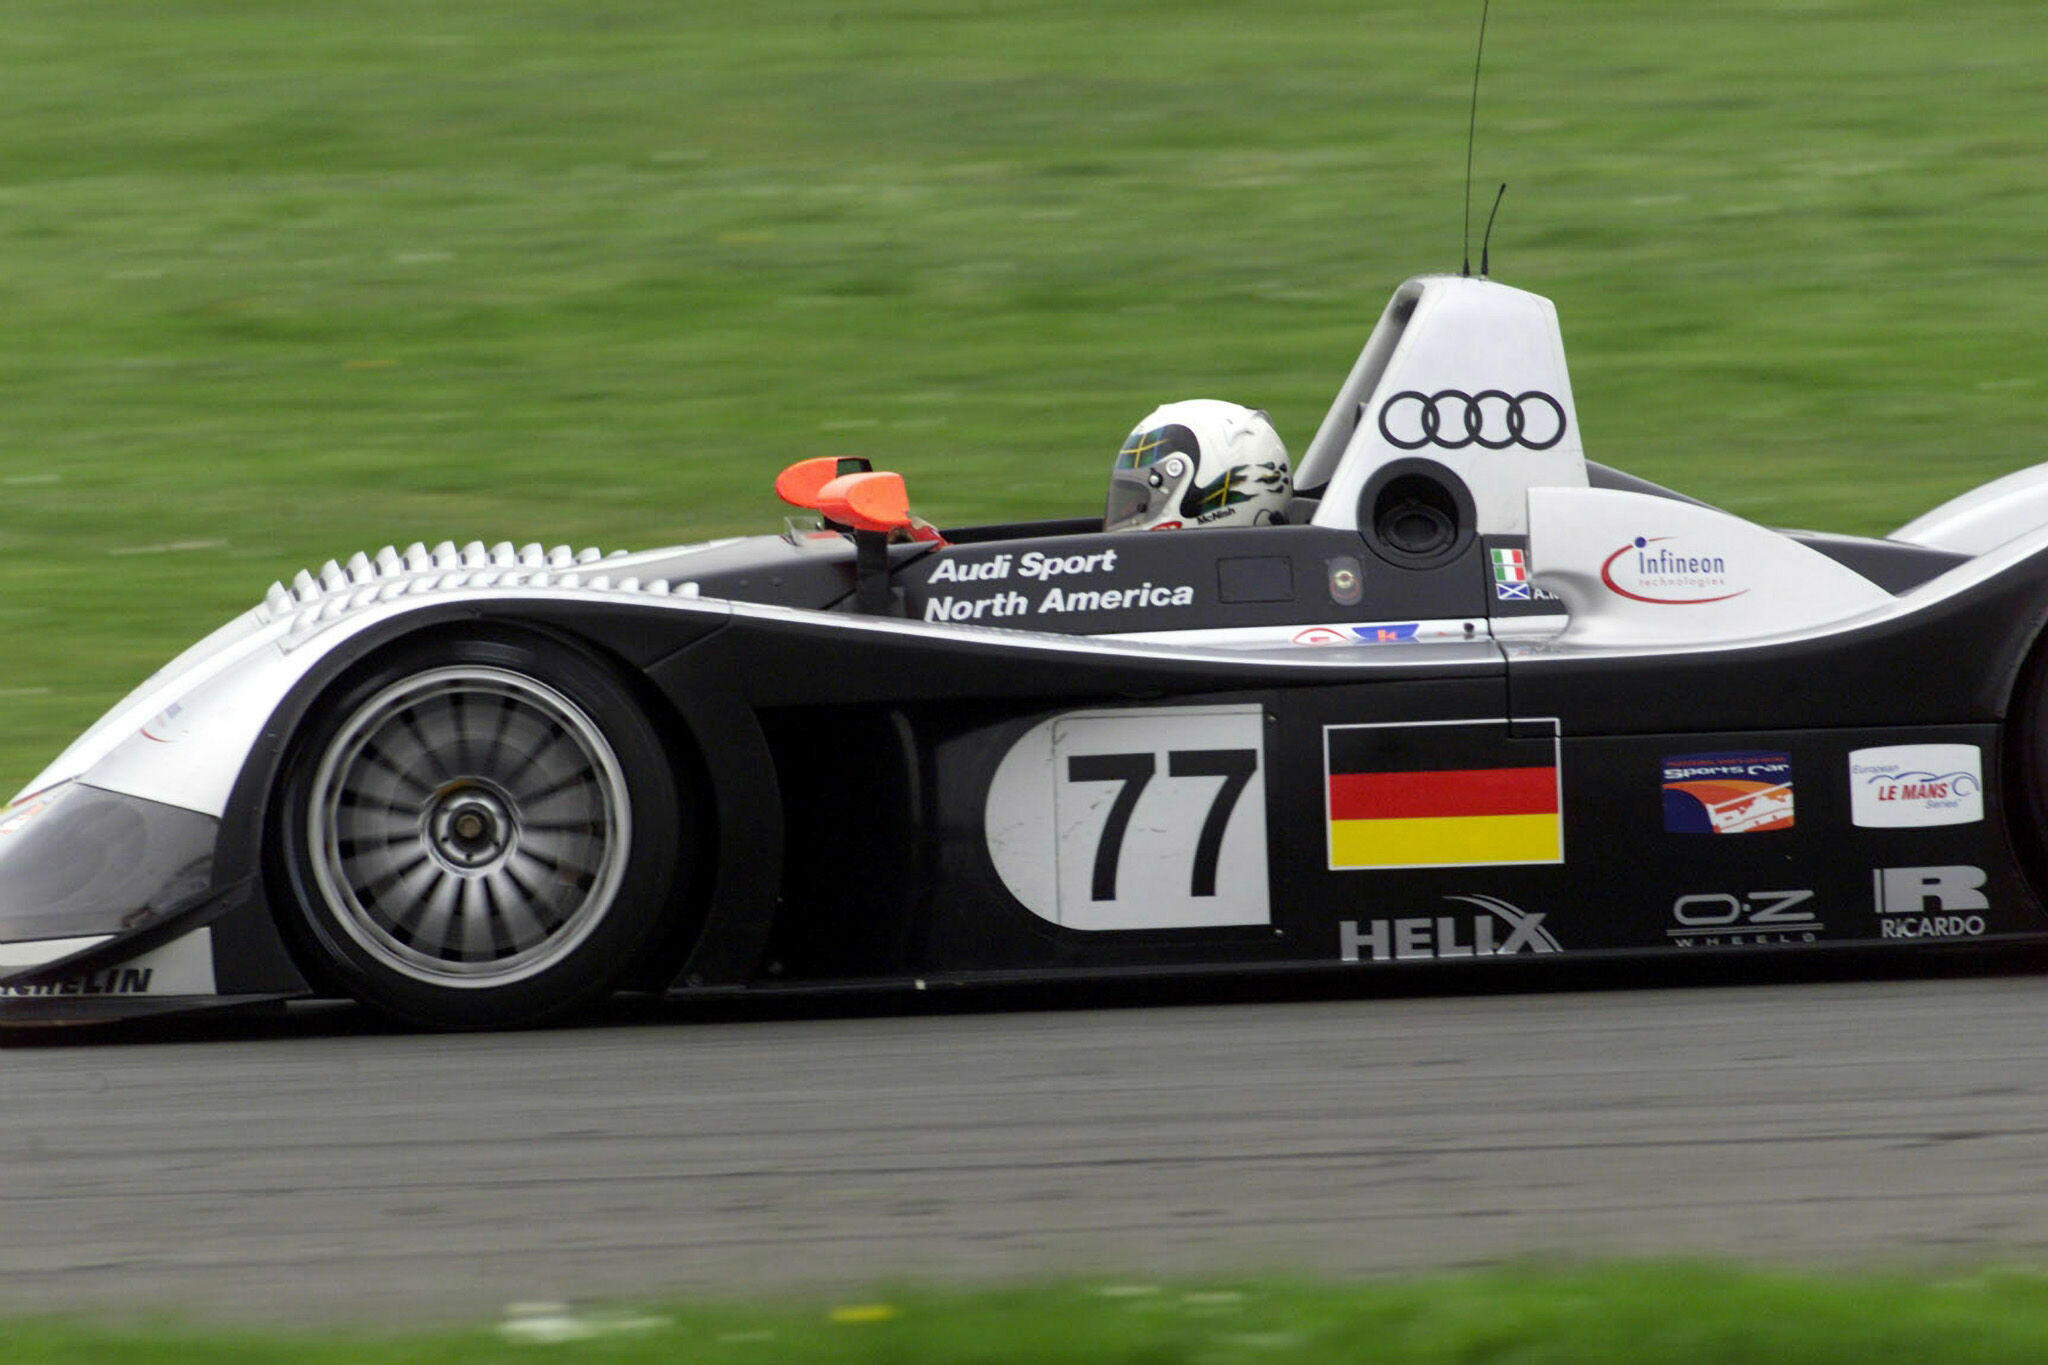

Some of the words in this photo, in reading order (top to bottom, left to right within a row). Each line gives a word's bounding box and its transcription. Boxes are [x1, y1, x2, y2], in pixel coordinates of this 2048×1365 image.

[927, 554, 1013, 584] Audi
[1017, 549, 1118, 581] Sport
[923, 591, 1029, 623] North
[1037, 582, 1195, 613] America
[1664, 766, 1744, 779] Sports
[1747, 764, 1790, 775] Car
[1878, 785, 1896, 801] LE
[1901, 782, 1949, 800] MANS
[1068, 748, 1258, 902] 77
[1339, 912, 1564, 962] HELIX
[1880, 915, 1987, 938] RICARDO
